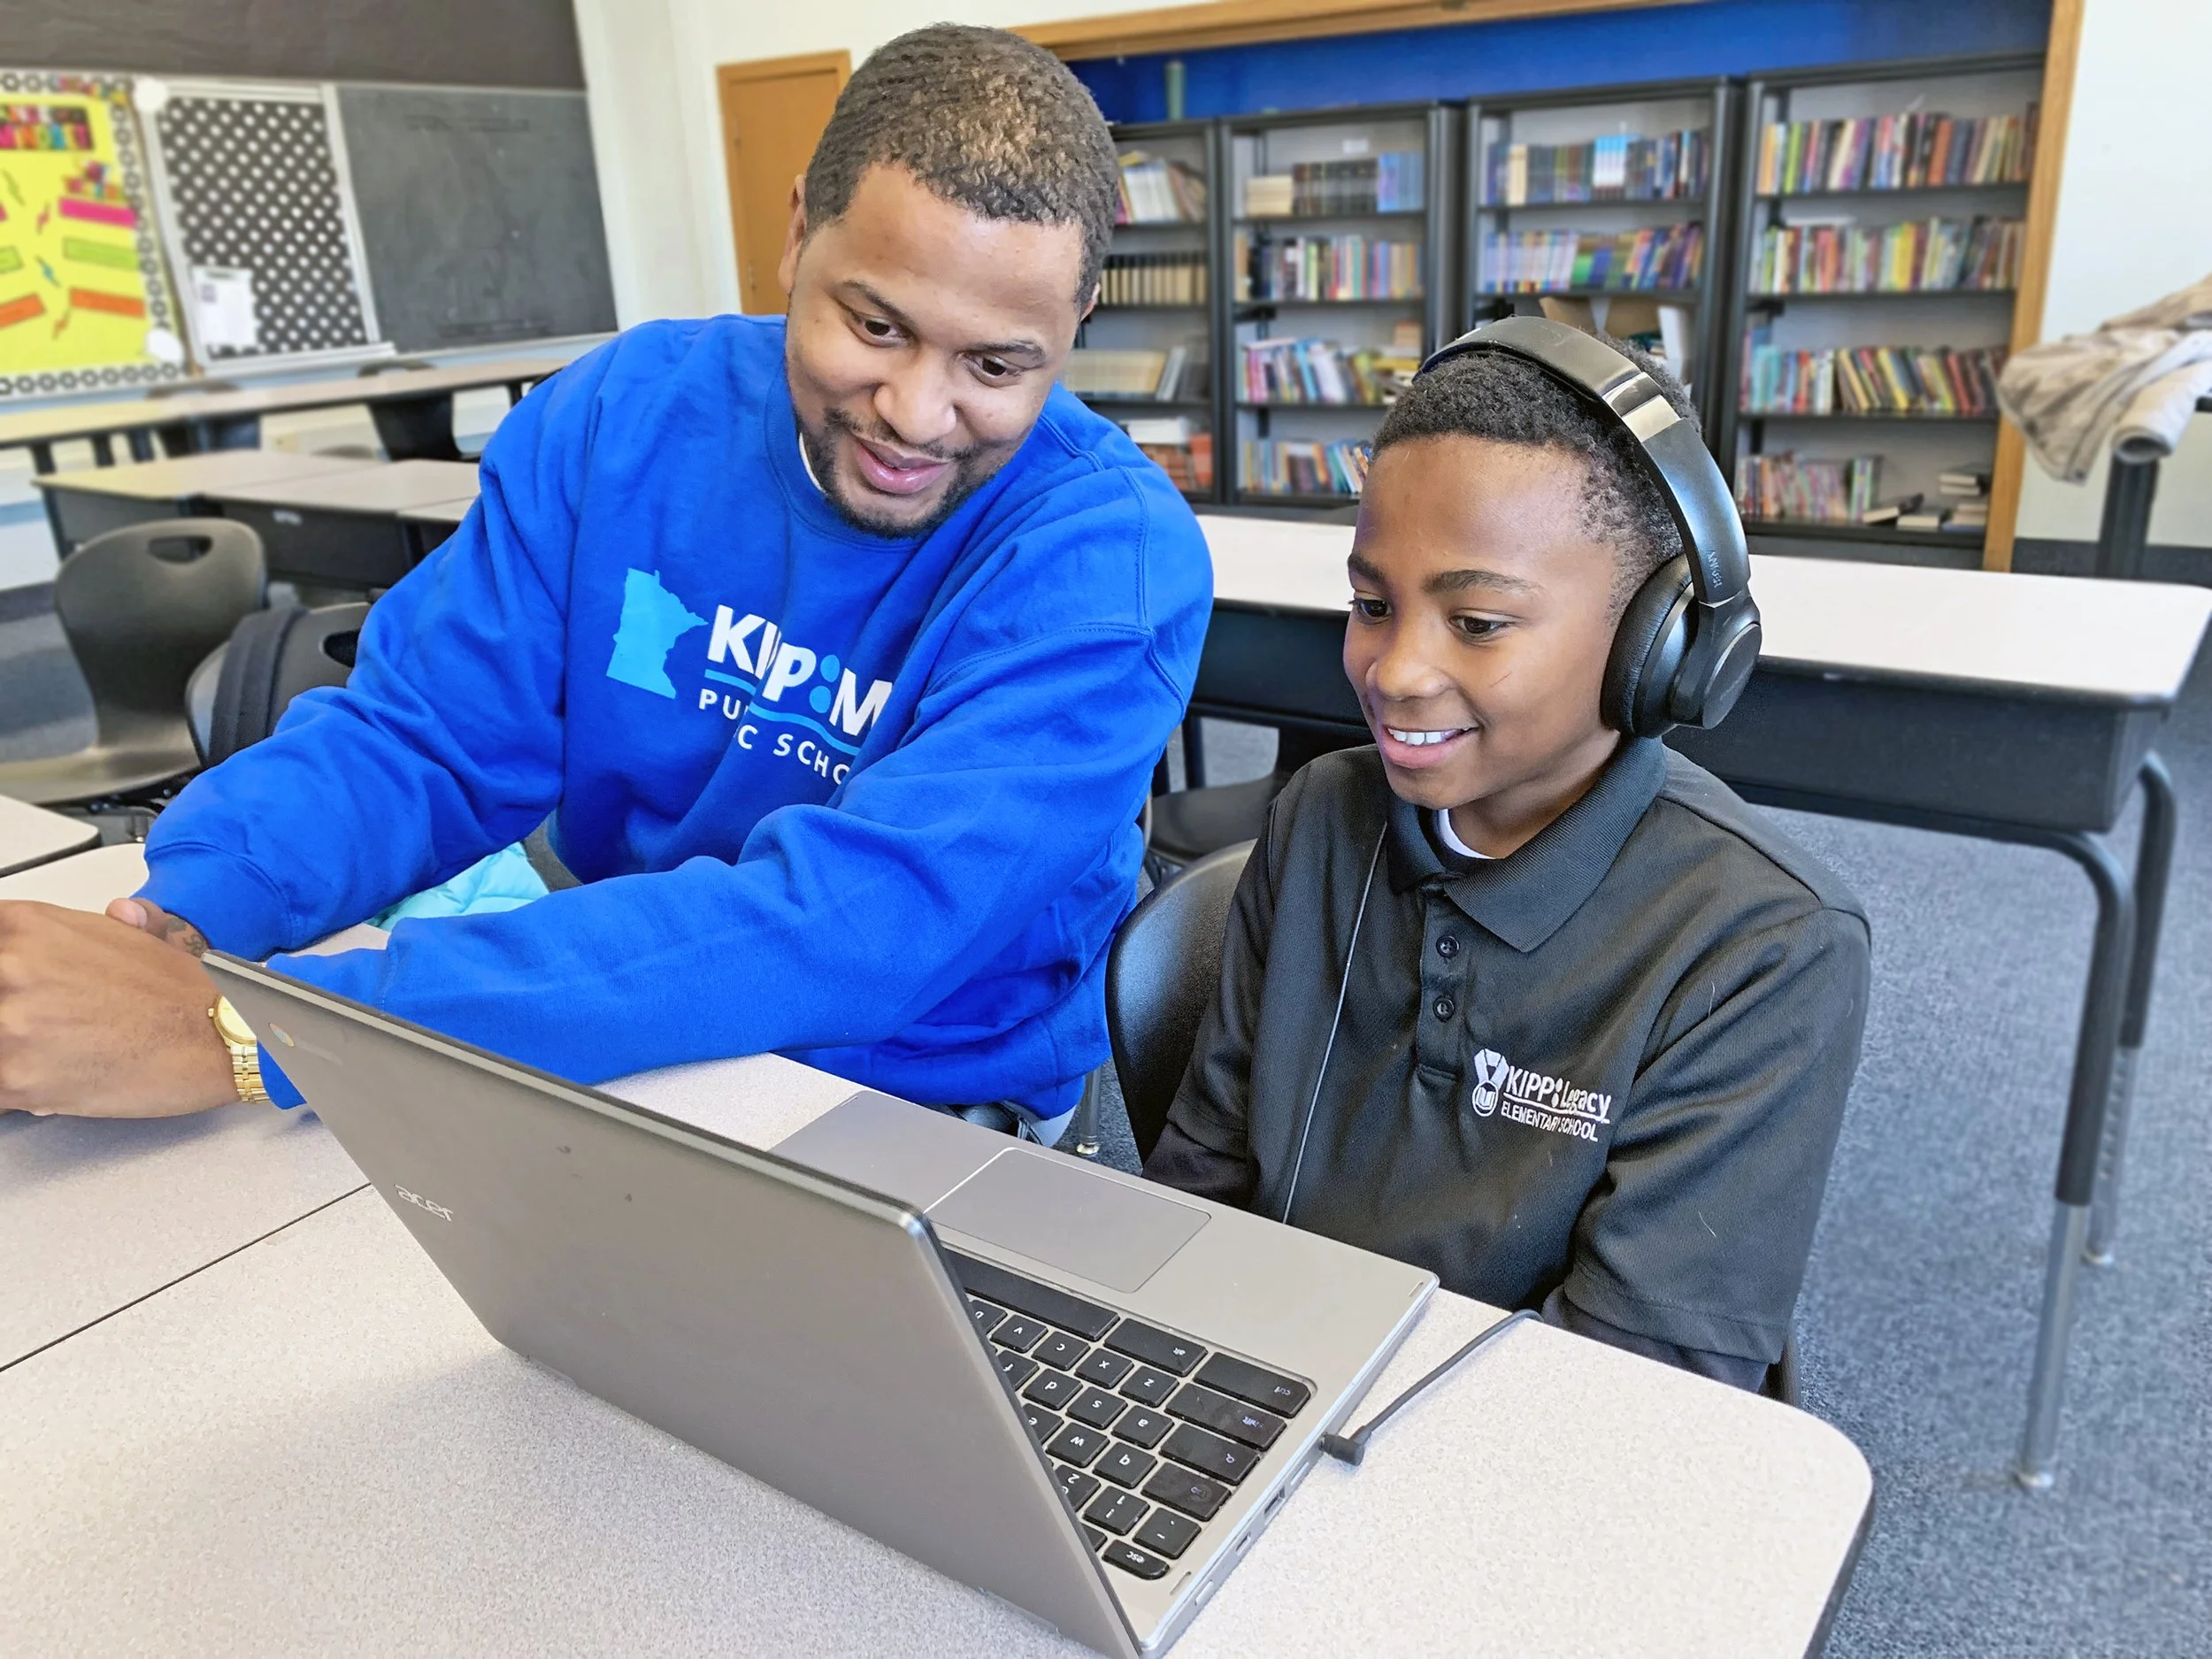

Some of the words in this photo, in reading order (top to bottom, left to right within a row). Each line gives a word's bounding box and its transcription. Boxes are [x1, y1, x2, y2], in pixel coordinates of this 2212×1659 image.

[698, 687, 758, 749] PUC
[1557, 1118, 1599, 1142] SCHOOL
[394, 1184, 454, 1221] acer
[1098, 1360, 1110, 1369] x
[1044, 1380, 1057, 1390] d
[1143, 1378, 1155, 1387] z
[1092, 1400, 1102, 1409] s
[1137, 1418, 1148, 1427] a
[1070, 1436, 1085, 1447] w
[1118, 1454, 1131, 1466] q
[1067, 1473, 1080, 1484] 2
[1125, 1550, 1145, 1563] esc
